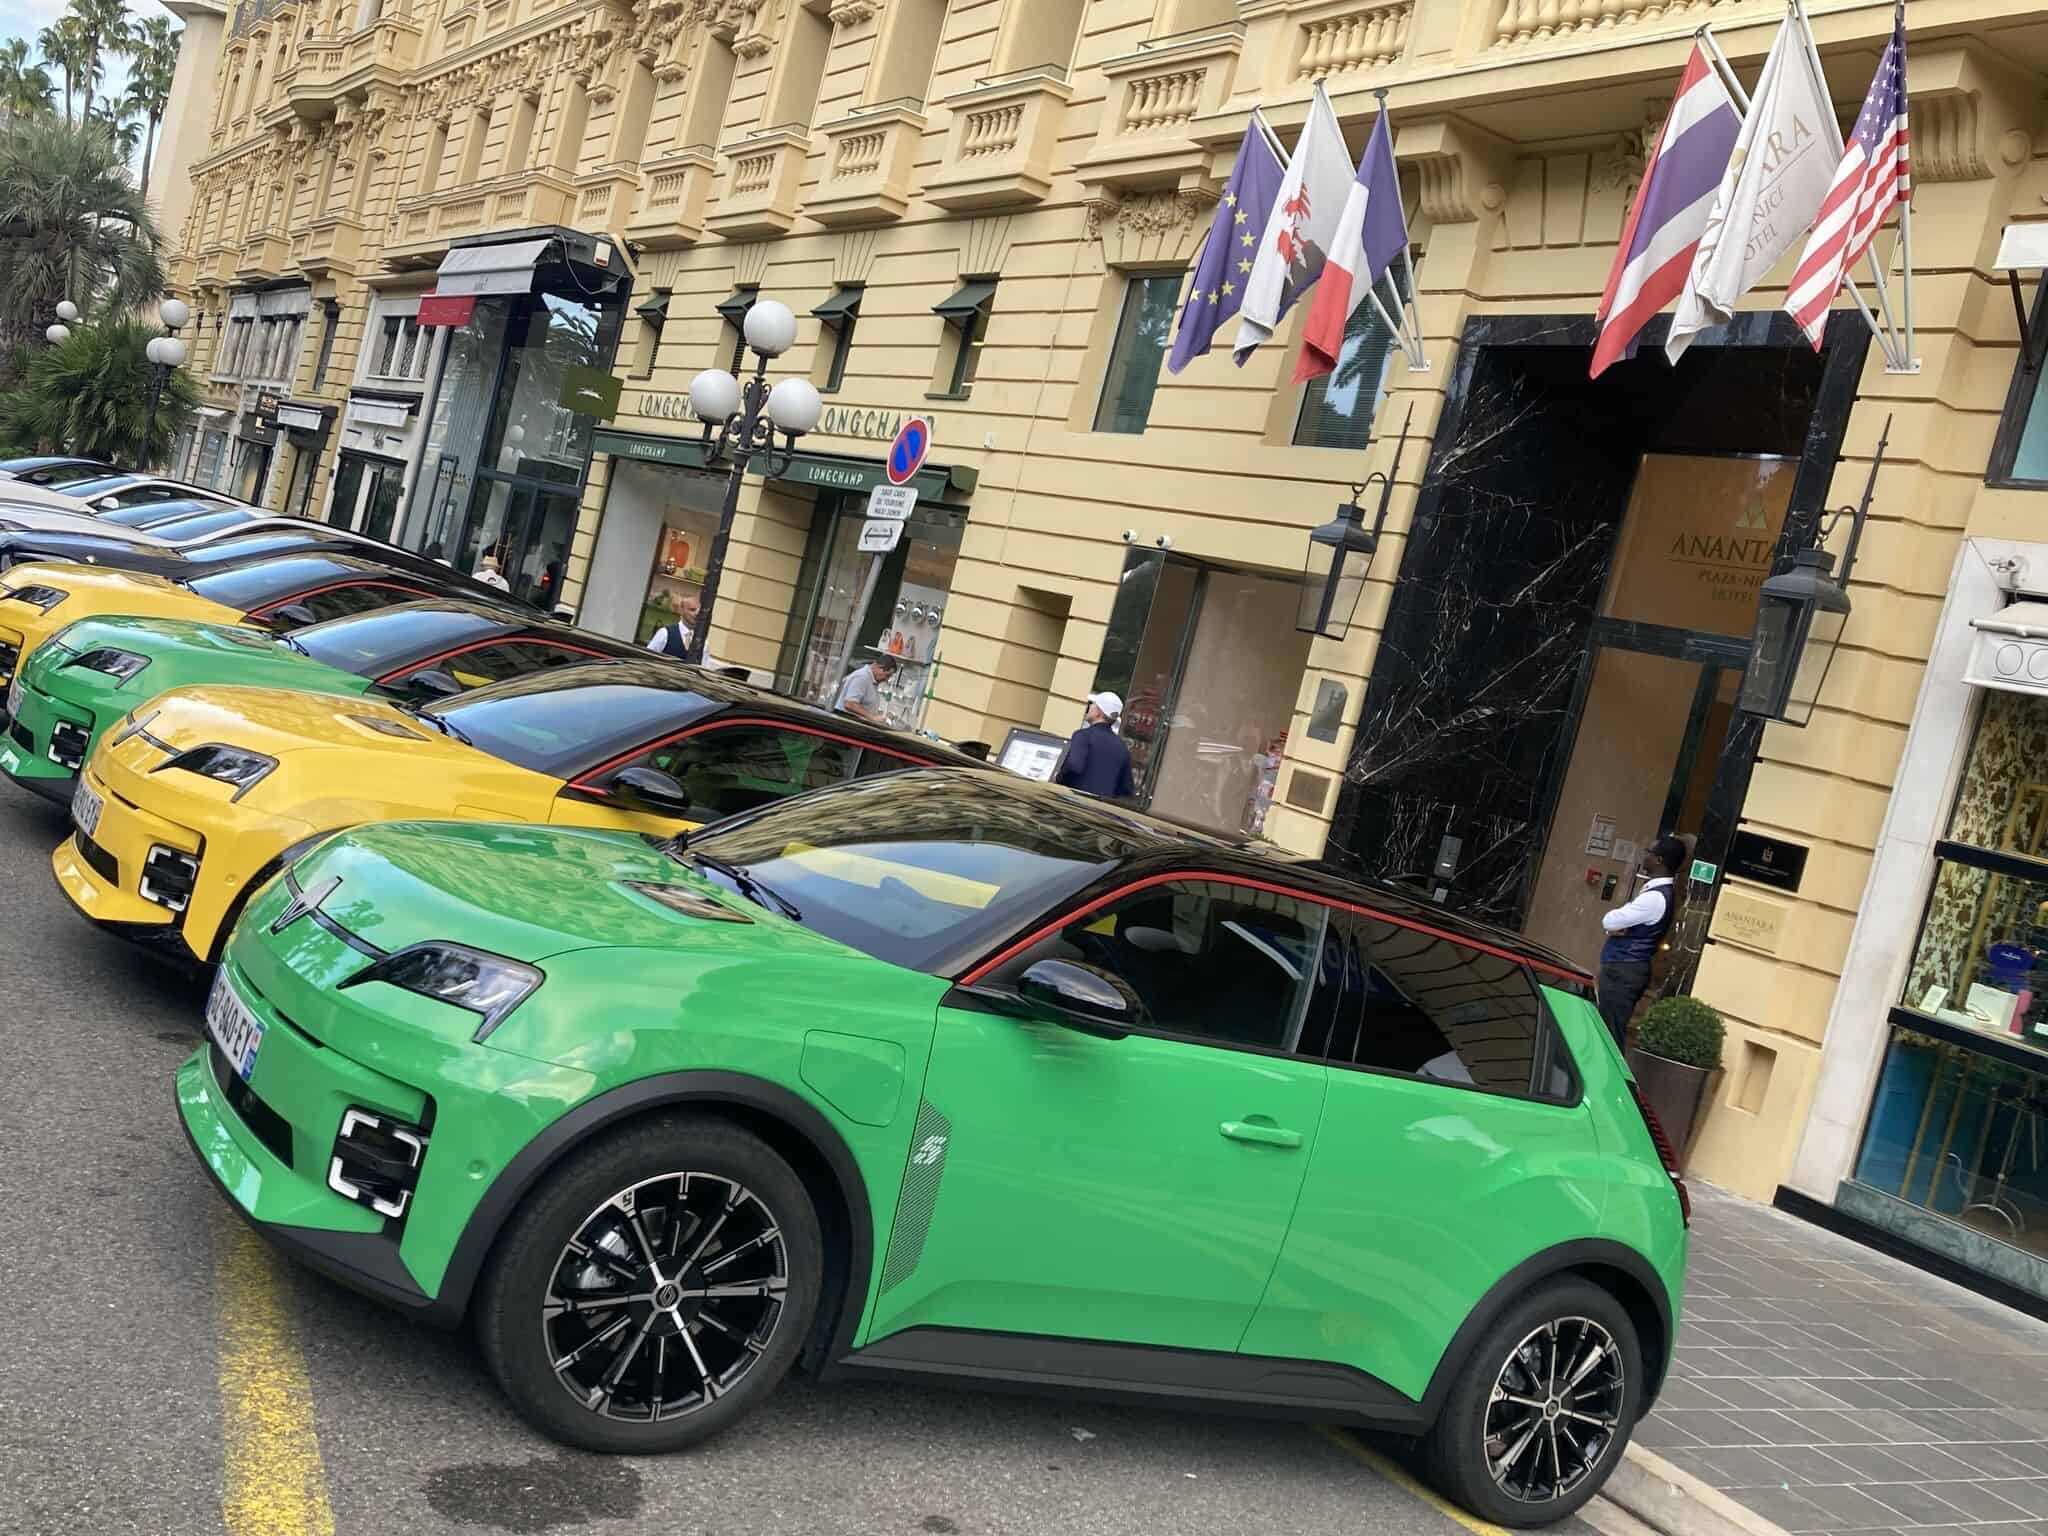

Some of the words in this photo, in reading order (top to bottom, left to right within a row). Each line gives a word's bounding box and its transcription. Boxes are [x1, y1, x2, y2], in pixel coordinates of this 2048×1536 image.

[811, 407, 935, 441] ONGCHA
[628, 443, 667, 458] LONGCHAMP
[808, 466, 864, 485] LONGCHAMP
